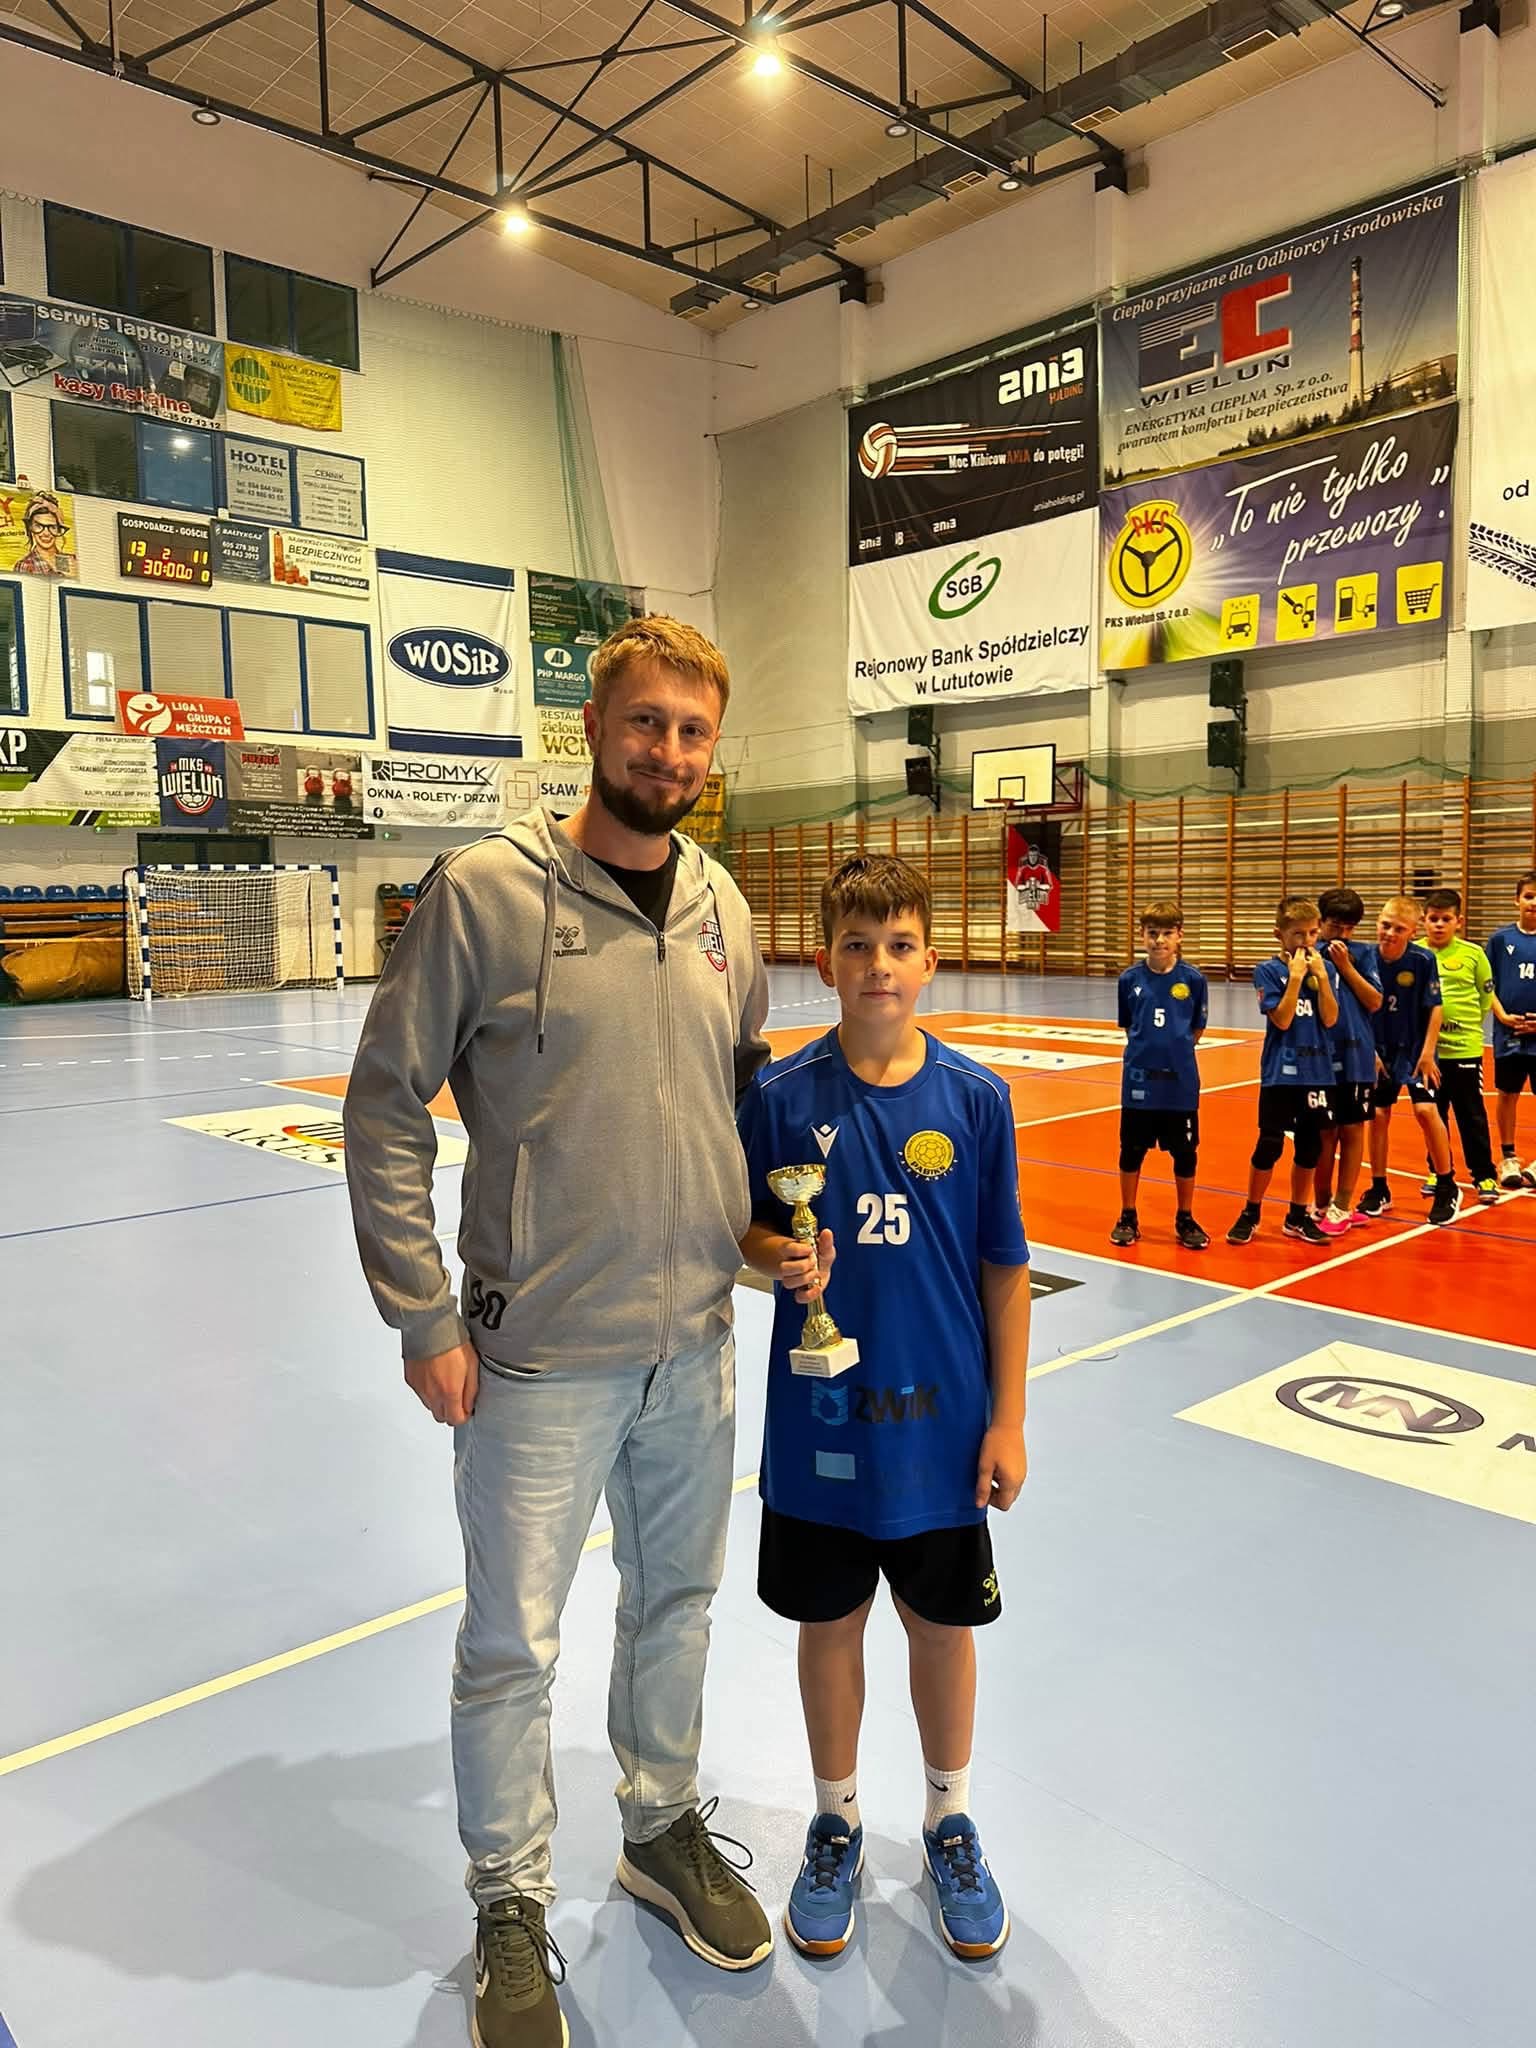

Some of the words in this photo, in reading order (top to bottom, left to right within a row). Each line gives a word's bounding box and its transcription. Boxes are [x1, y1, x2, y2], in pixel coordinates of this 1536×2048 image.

[1112, 298, 1154, 322] Ciepło
[1157, 274, 1226, 311] przyjazne
[1229, 264, 1253, 281] dla
[1257, 237, 1329, 271] Odbiorcy
[1333, 229, 1340, 245] i
[1342, 194, 1445, 242] środowiska
[36, 303, 111, 331] serwis
[116, 317, 211, 354] laptopów
[1140, 353, 1292, 409] WIELUŃ
[53, 373, 105, 400] kasy
[110, 382, 192, 414] fiskalne
[1117, 429, 1179, 455] gwarantem
[1181, 413, 1237, 435] komfortu
[1246, 383, 1349, 421] bezpieczeństwa
[1125, 406, 1205, 436] ENERGETYKA
[1210, 388, 1267, 413] CIEPLNA
[1274, 382, 1295, 397] Sp.
[230, 449, 287, 470] HOTEL
[948, 455, 969, 468] Moc
[1034, 448, 1045, 462] do
[1266, 482, 1306, 524] nie
[1323, 436, 1409, 520] tylko
[1503, 479, 1529, 501] od
[122, 518, 175, 534] GOSPODARZE
[180, 527, 209, 539] GOŚCIE
[1131, 508, 1169, 538] PKS
[130, 540, 147, 557] 13
[162, 548, 171, 560] 2
[1277, 499, 1422, 585] przewozy
[288, 545, 362, 565] BEZPIECZNYCH
[201, 570, 211, 582] 0
[946, 575, 982, 598] SGB
[1104, 617, 1123, 628] PKS
[404, 640, 499, 676] WOSiR
[855, 653, 928, 680] Rejonowy
[932, 644, 974, 667] Bank
[979, 625, 1090, 663] Spółdzielczy
[536, 668, 553, 678] PHP
[555, 670, 586, 682] MARGO
[915, 680, 928, 695] w
[932, 665, 1013, 693] Lututowie
[172, 702, 197, 713] LIGA
[175, 723, 231, 736] MĘŻCZYZN
[187, 713, 221, 725] GRUPA
[223, 716, 231, 725] C
[178, 757, 204, 772] MKS
[391, 761, 493, 786] PROMYK
[161, 771, 224, 799] WIELUŃ
[367, 788, 403, 800] OKNA
[413, 792, 458, 803] ROLETY
[464, 794, 500, 803] DRZWI
[1518, 963, 1535, 979] 14
[1153, 1007, 1166, 1028] 5
[1295, 999, 1313, 1017] 64
[1308, 1090, 1328, 1109] 64
[856, 1193, 911, 1246] 25
